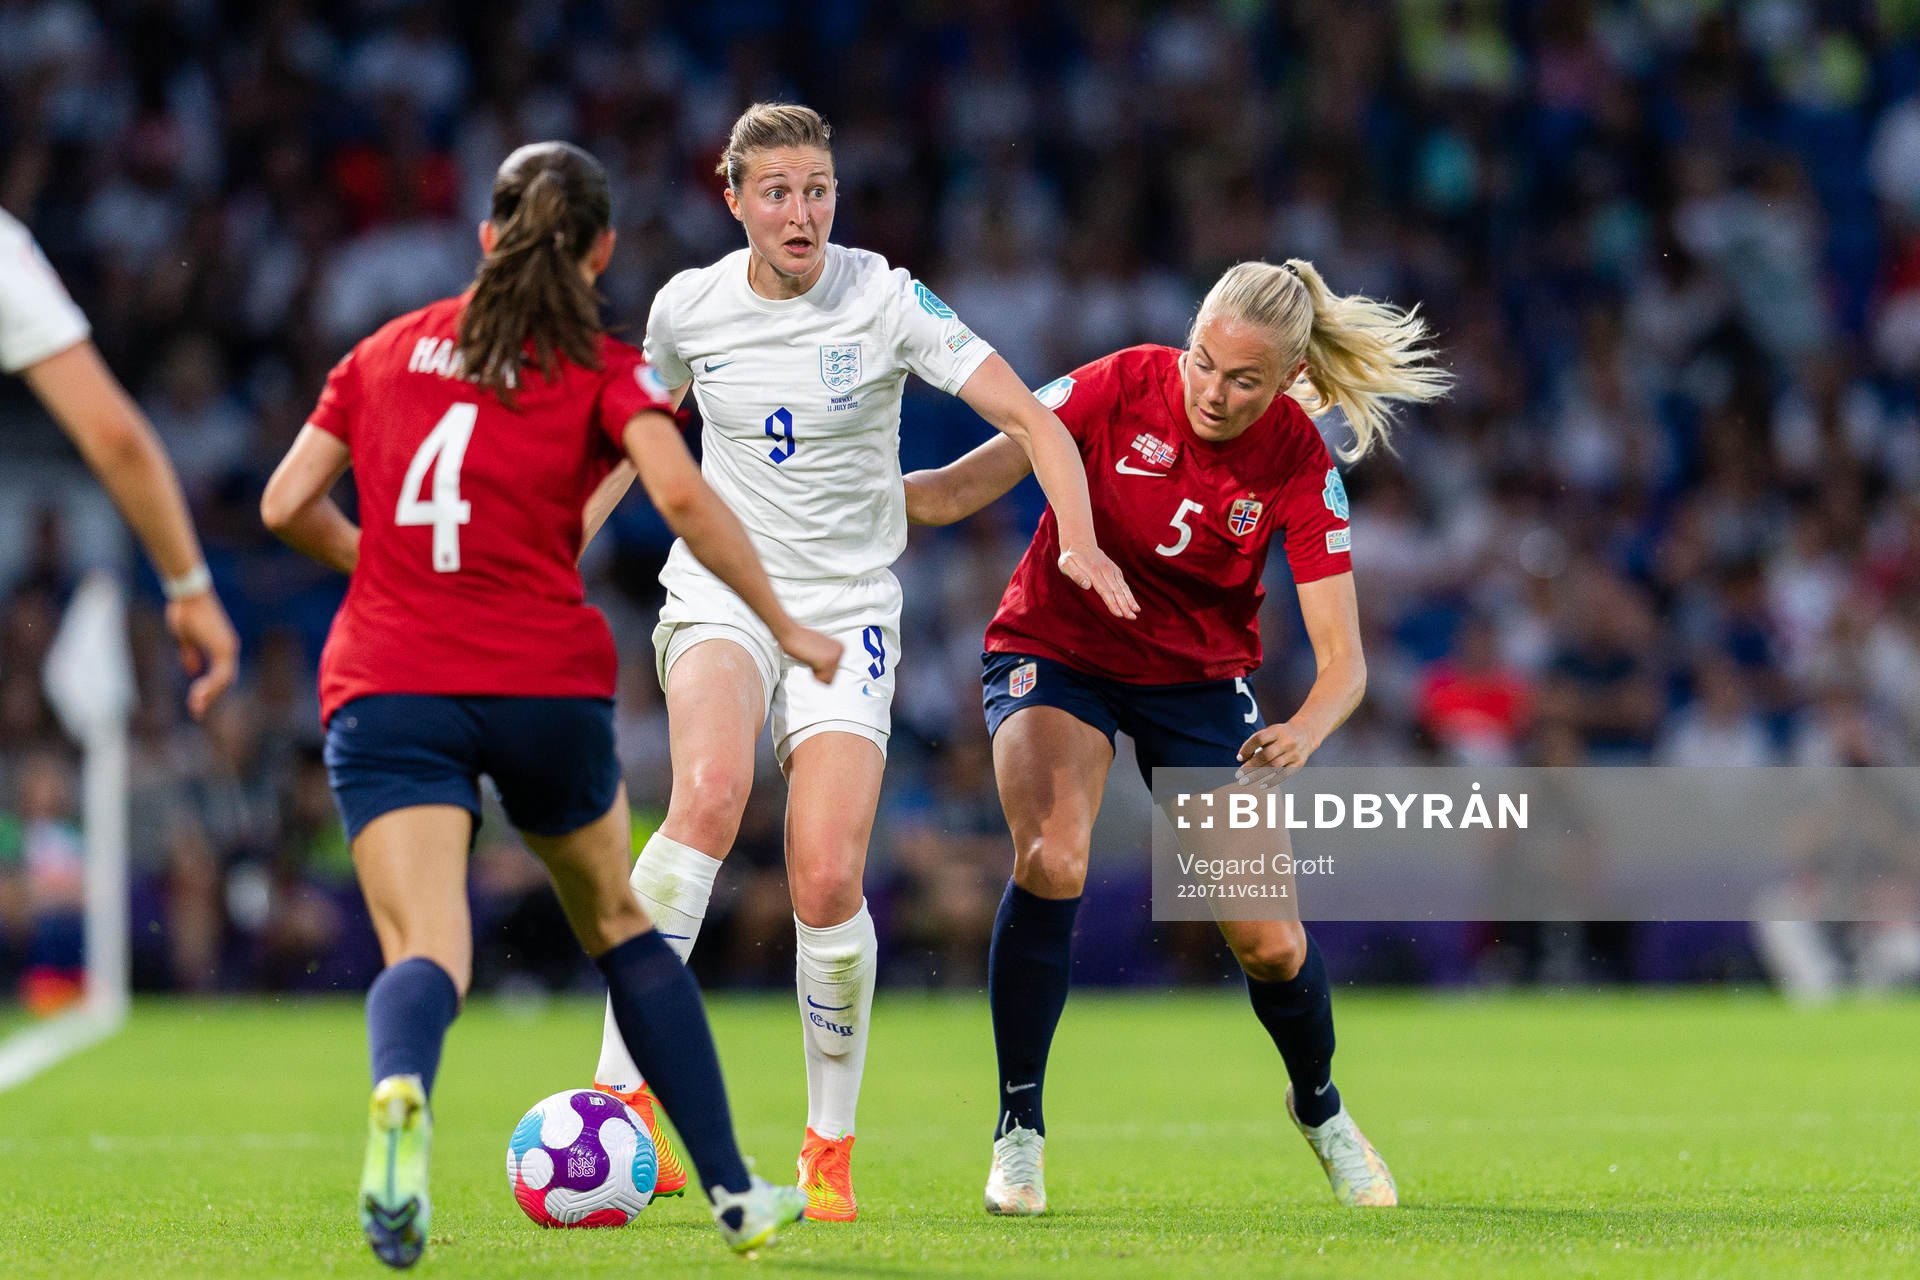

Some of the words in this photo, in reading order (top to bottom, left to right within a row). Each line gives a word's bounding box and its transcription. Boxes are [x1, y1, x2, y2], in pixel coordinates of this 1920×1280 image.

[831, 396, 853, 404] NORWAY
[833, 404, 846, 412] JULY
[765, 406, 796, 465] 9
[394, 402, 478, 573] 4
[1154, 498, 1204, 557] 5
[862, 625, 886, 680] 9
[1234, 677, 1258, 724] 5
[809, 1011, 854, 1037] Eng
